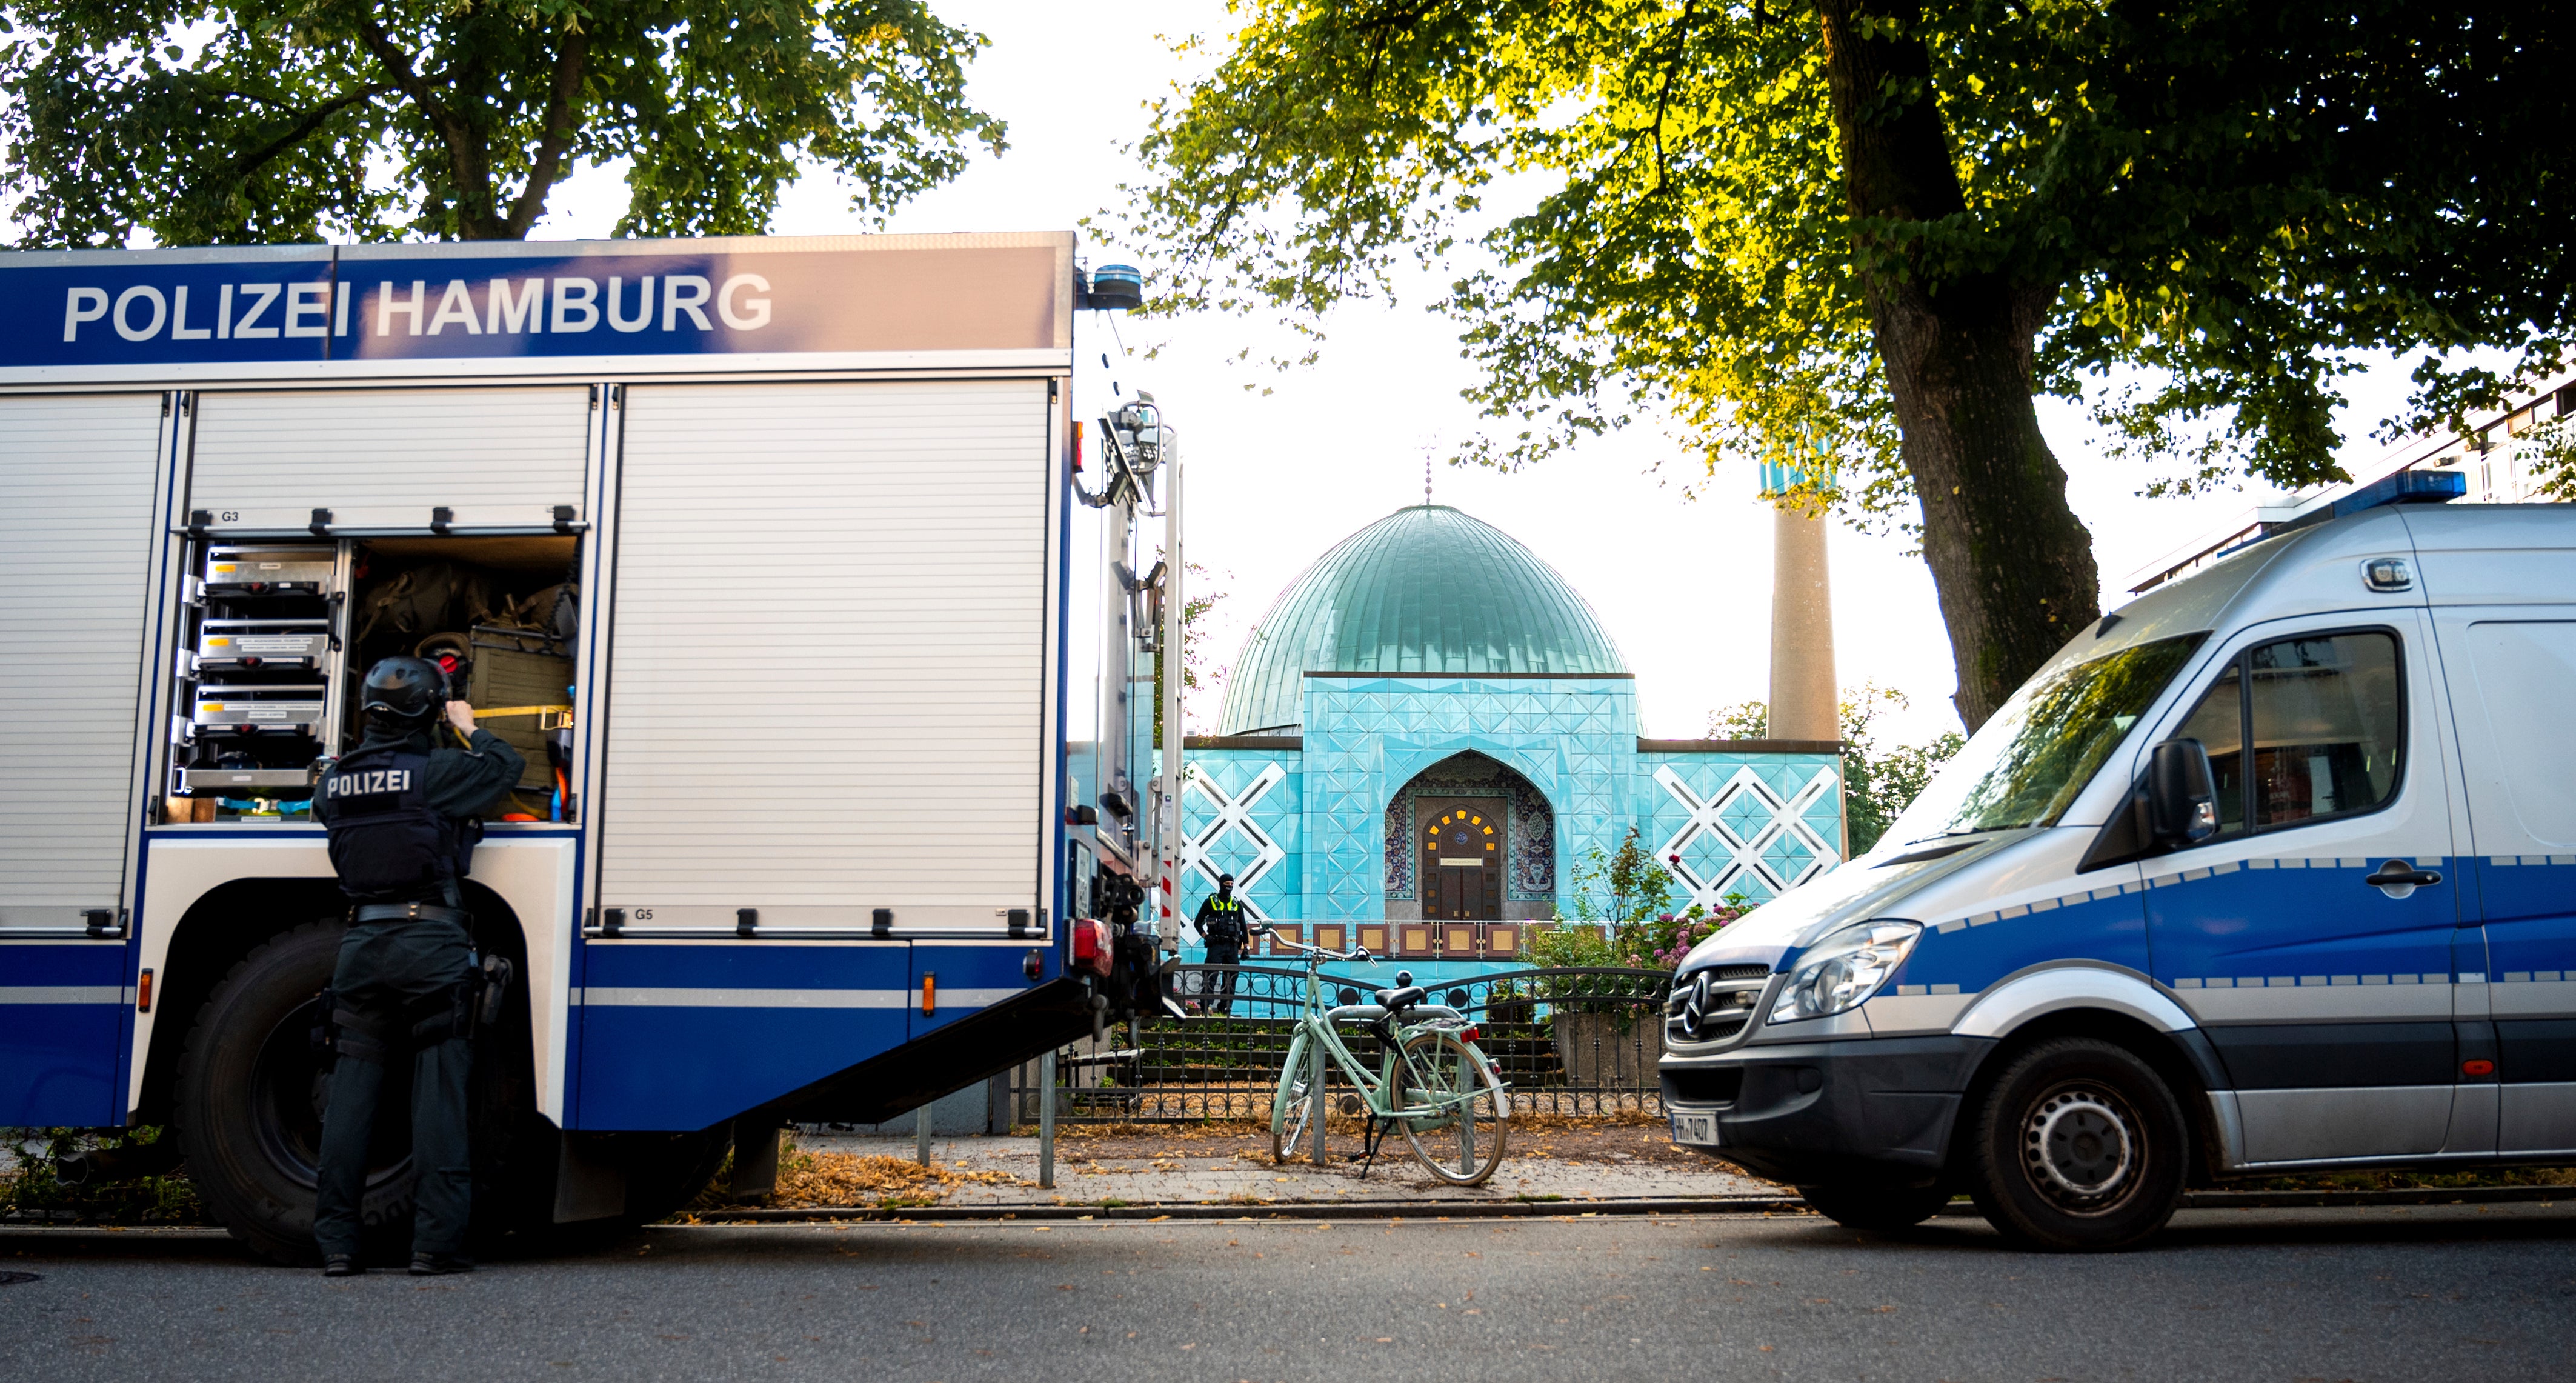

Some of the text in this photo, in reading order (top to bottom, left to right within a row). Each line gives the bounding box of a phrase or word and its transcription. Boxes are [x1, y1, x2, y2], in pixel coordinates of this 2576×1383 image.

[63, 273, 772, 342] POLIZEI HAMBURG
[222, 512, 238, 522] G3
[327, 770, 410, 799] POLIZEI
[636, 908, 653, 920] G5
[1688, 1118, 1708, 1142] 7407
